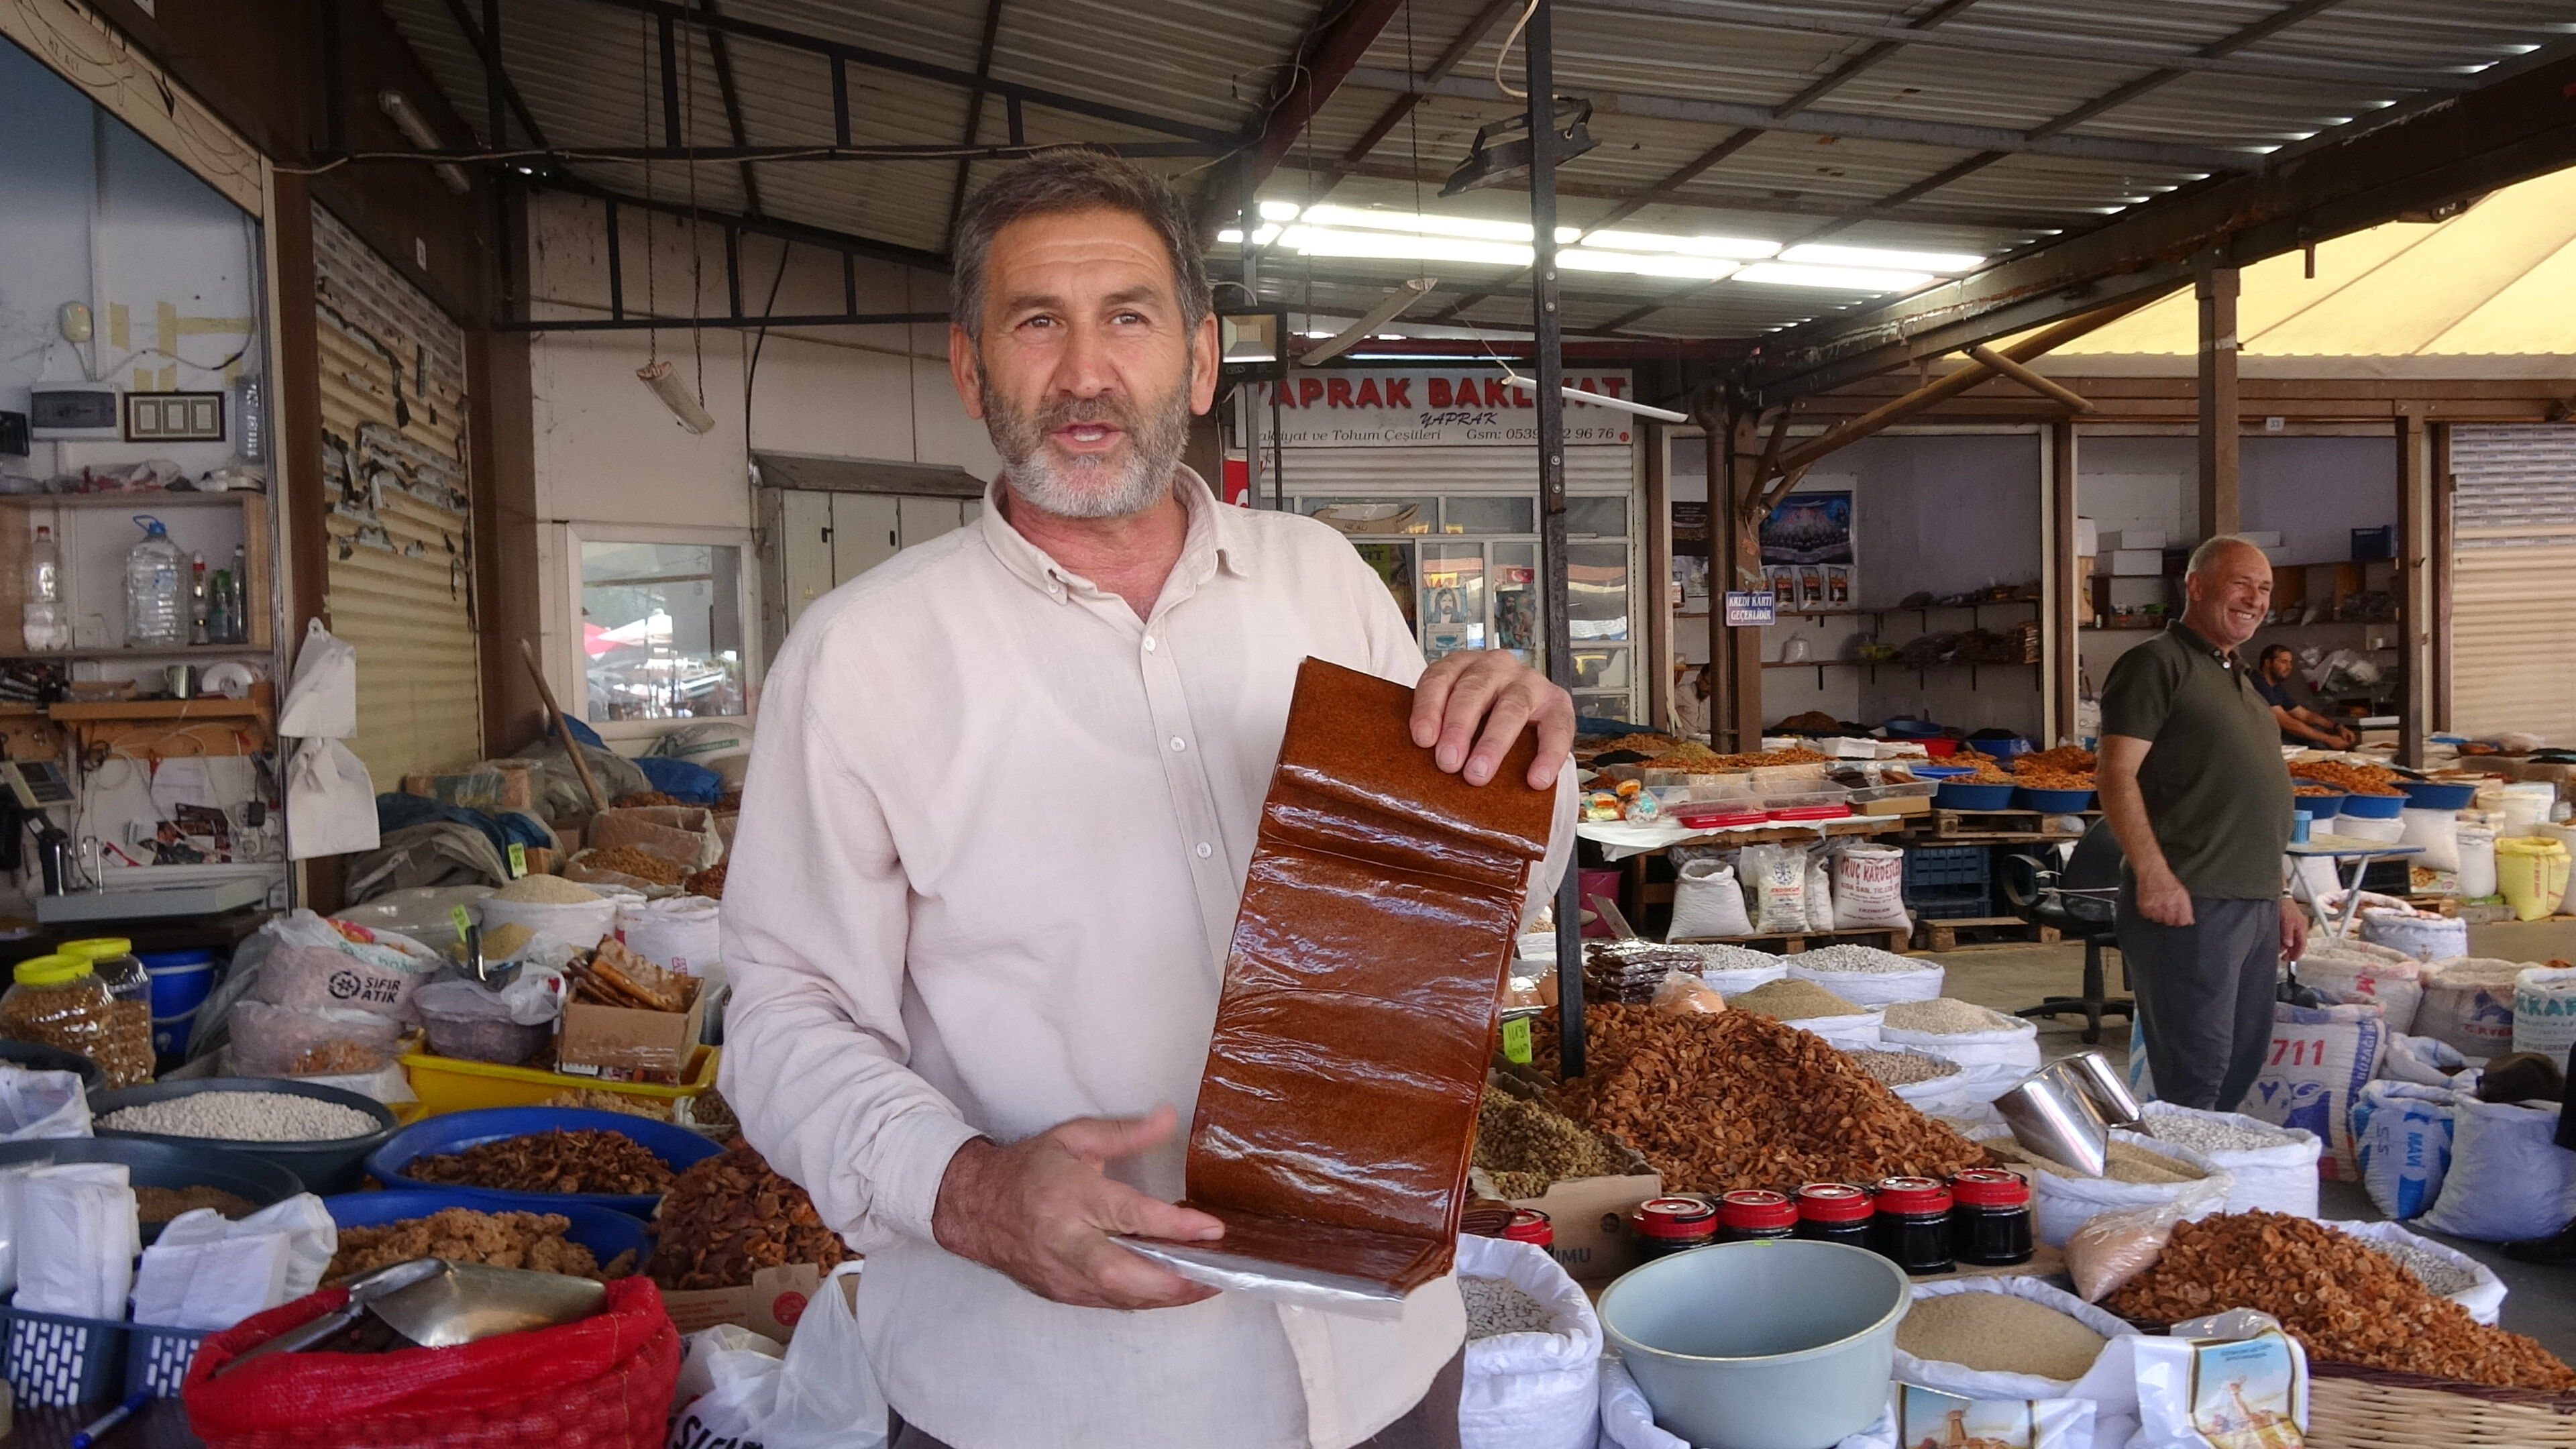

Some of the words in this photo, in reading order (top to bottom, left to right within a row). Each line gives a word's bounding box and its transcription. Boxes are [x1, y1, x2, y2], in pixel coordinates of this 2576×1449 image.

[1258, 378, 1411, 409] APRAK
[1419, 412, 1497, 428] YAPRAK
[1258, 430, 1307, 444] akiyat
[1313, 431, 1328, 441] ve
[1332, 429, 1380, 441] Tohum
[1384, 429, 1442, 443] Çeşitleri
[1467, 429, 1501, 440] Gsm:
[1506, 429, 1539, 440] 0539
[1574, 429, 1593, 439] 96
[1597, 428, 1614, 439] 76
[364, 977, 402, 991] SIFIR
[360, 989, 398, 1004] ATIK
[2269, 1038, 2325, 1066] 711
